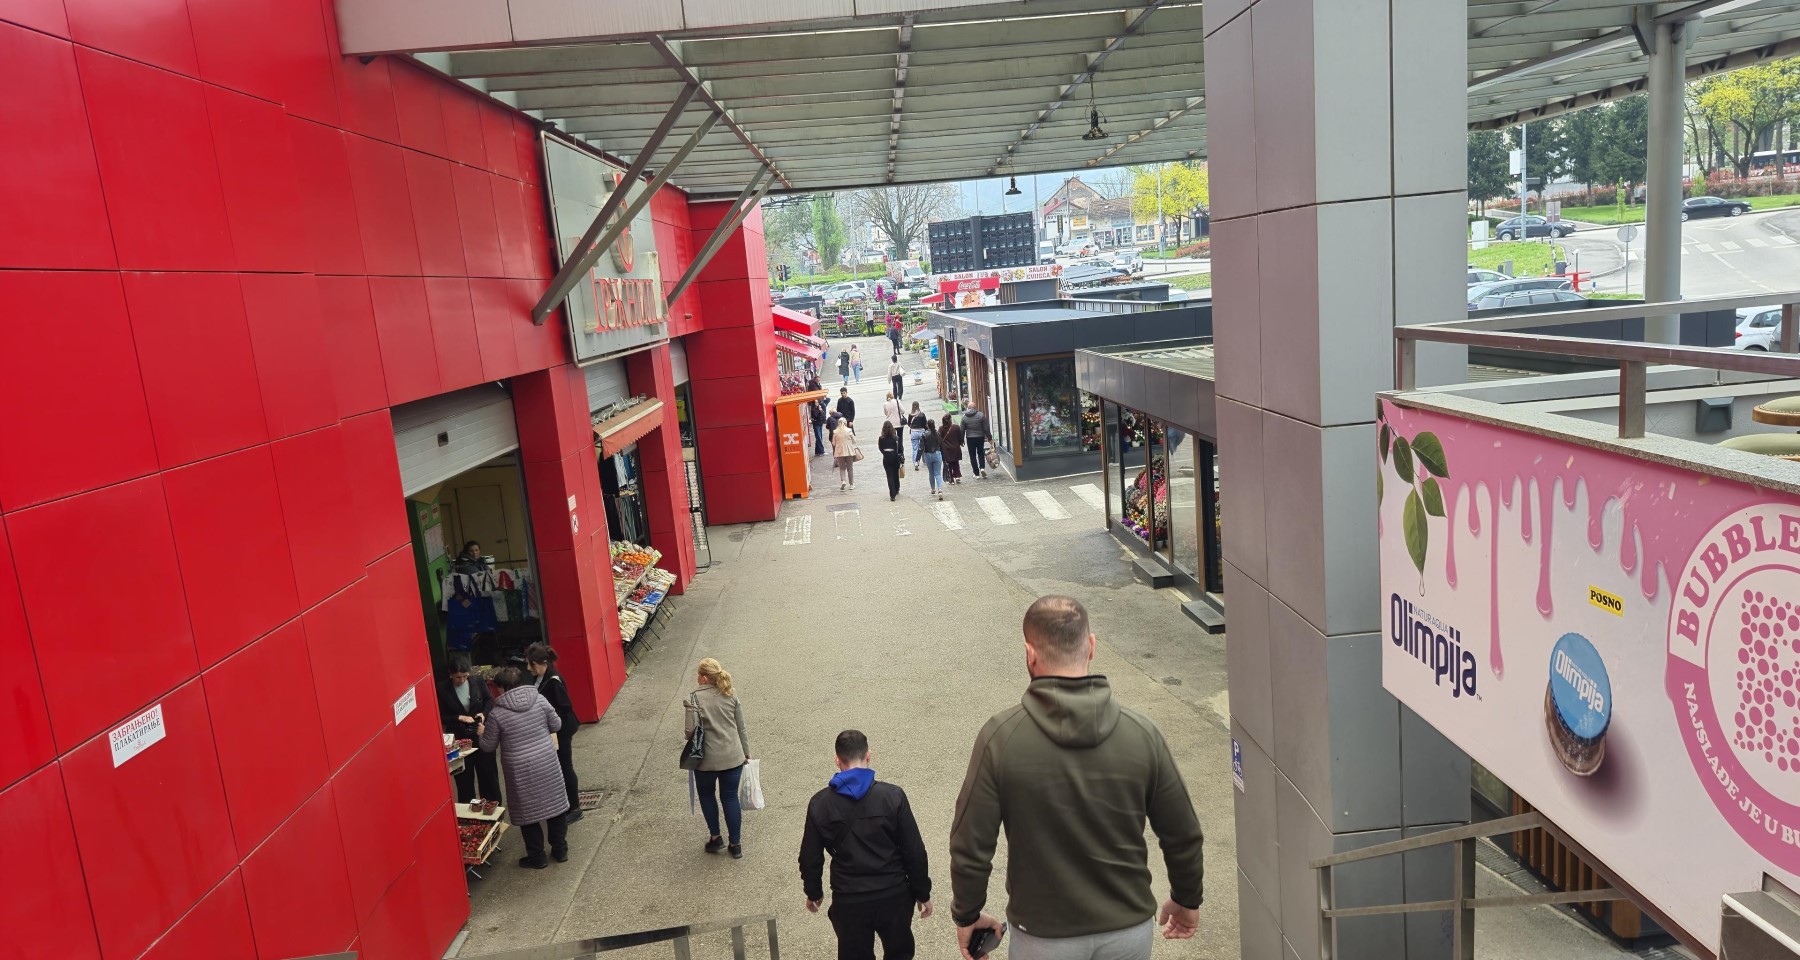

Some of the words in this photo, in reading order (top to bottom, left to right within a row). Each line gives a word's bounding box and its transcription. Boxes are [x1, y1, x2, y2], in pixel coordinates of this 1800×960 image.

[1028, 265, 1048, 273] SALON
[1676, 513, 1800, 647] BUBBLE
[1589, 589, 1622, 612] POSNO
[1413, 605, 1449, 634] NATURAQUA
[1390, 592, 1477, 698] Olimpija
[1555, 649, 1604, 712] Olimpija
[111, 708, 159, 743] ЗАБРАЊЕНО!
[113, 717, 161, 752] ПЛАКАТИРАЊЕ
[1233, 740, 1240, 756] P
[1684, 682, 1740, 800] NAJSLAĐE
[1738, 796, 1762, 825] JE
[1764, 813, 1779, 835] U
